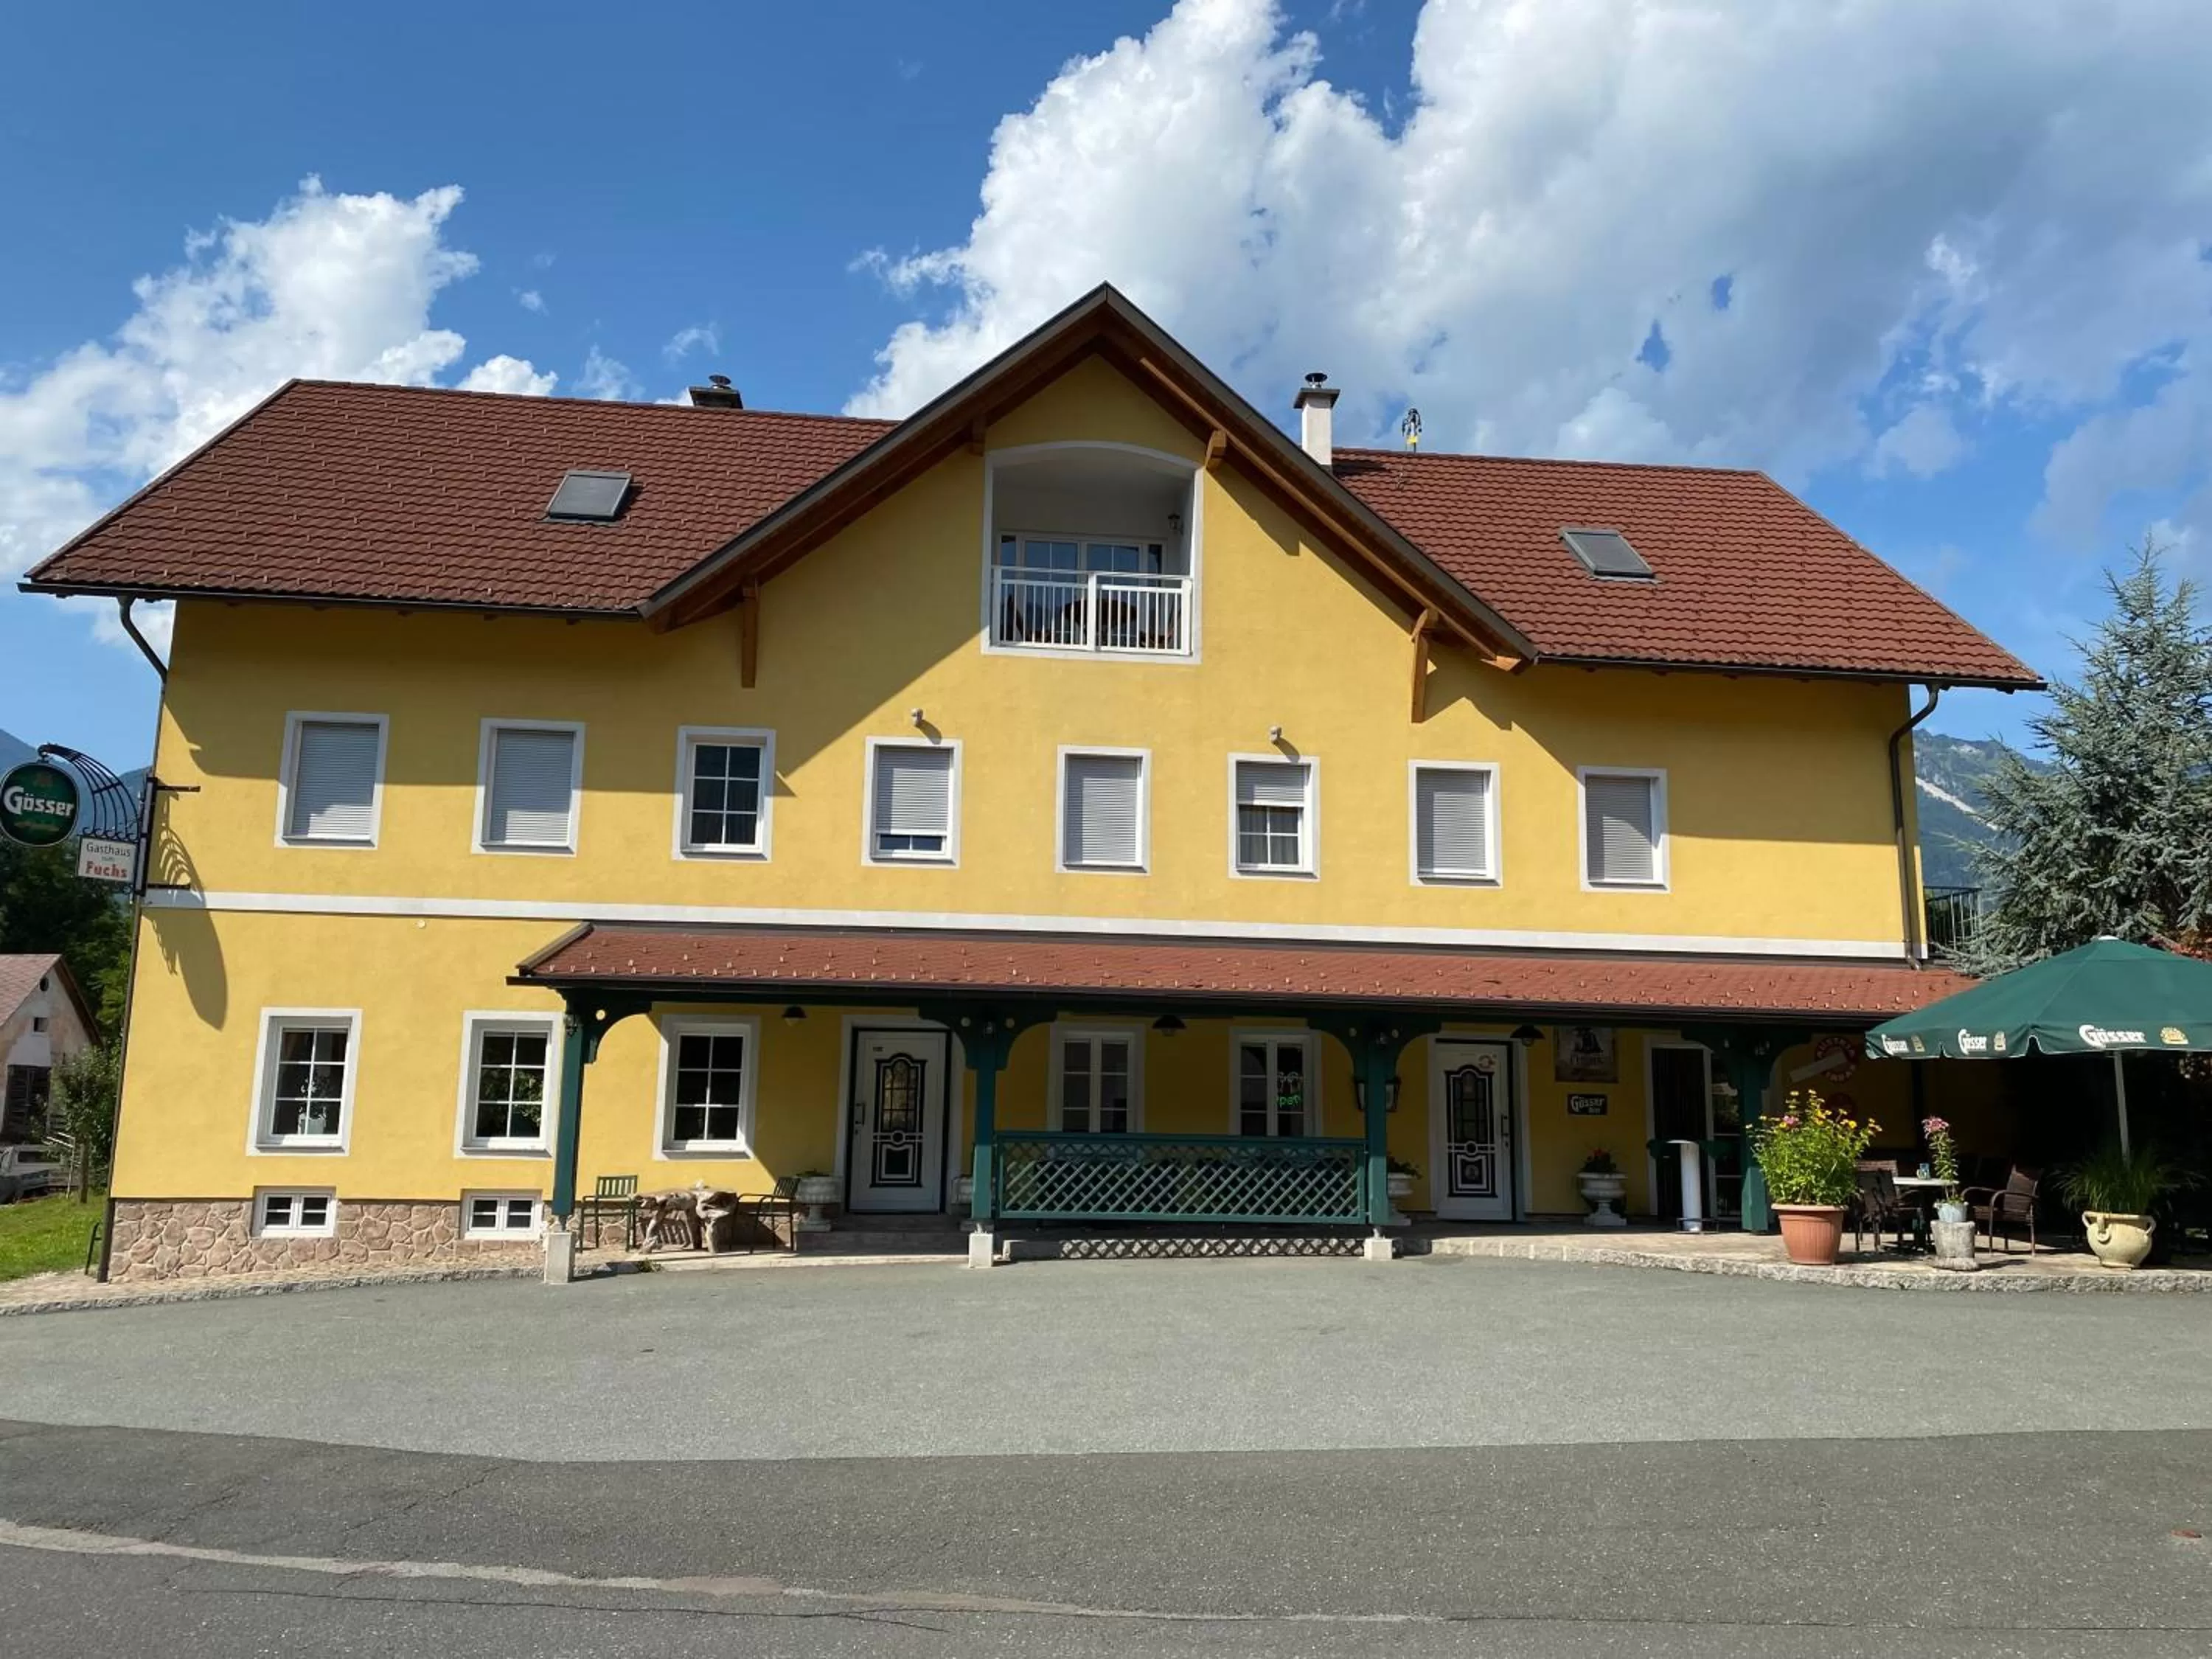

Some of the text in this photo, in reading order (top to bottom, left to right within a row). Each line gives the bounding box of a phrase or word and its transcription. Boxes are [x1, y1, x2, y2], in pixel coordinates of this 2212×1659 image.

[3, 785, 74, 816] Gösser
[86, 841, 131, 858] Gasthaus
[85, 861, 128, 878] Fuchs
[2079, 1024, 2147, 1049] Gösser
